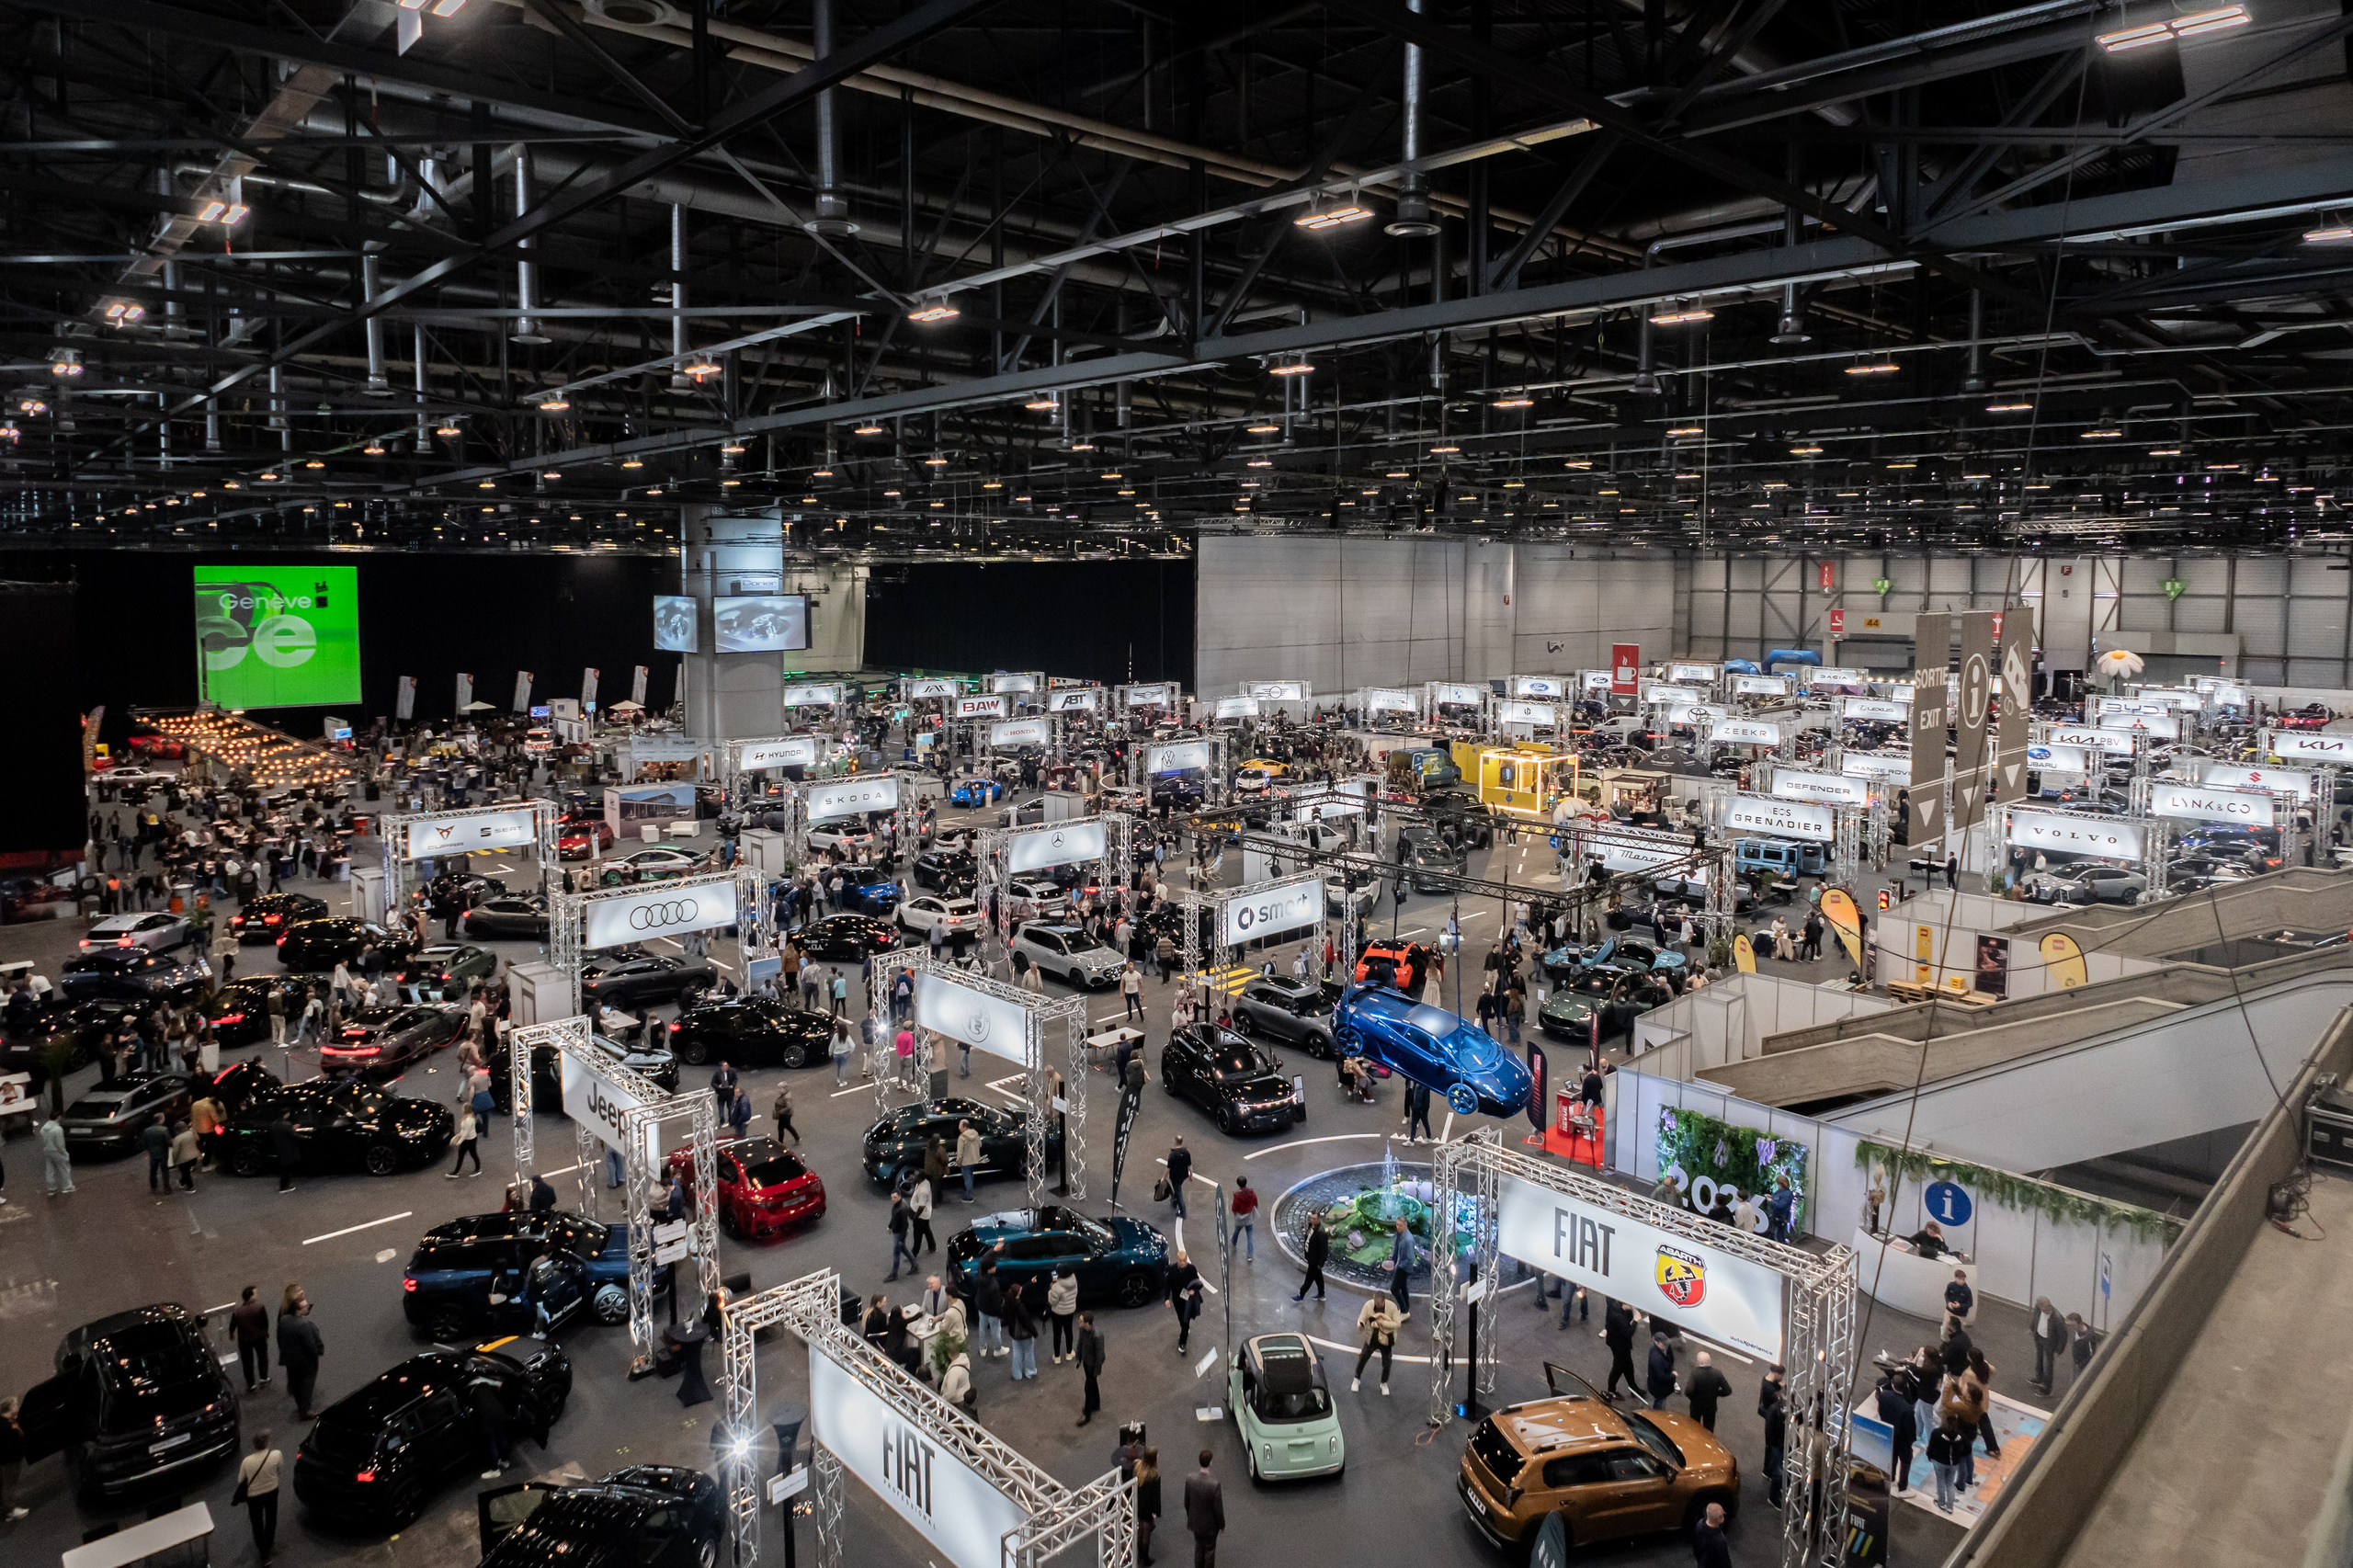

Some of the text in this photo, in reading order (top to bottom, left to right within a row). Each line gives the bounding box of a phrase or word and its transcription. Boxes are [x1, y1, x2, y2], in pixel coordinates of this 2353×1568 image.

[219, 593, 312, 610] Genève
[1915, 666, 1949, 689] SORTIE
[962, 699, 1000, 712] BAW
[1061, 694, 1086, 709] ABT
[1920, 707, 1942, 730] EXIT
[1723, 727, 1768, 738] ZEEKR
[2099, 737, 2120, 746] PBV
[2299, 739, 2344, 752] KIA
[768, 748, 804, 760] HYUNDAI
[1853, 765, 1886, 774] RANGE
[2027, 761, 2057, 769] UBARU
[1786, 781, 1851, 796] DEFENDER
[1763, 804, 1792, 817] INEOS
[494, 825, 523, 835] SEAT
[1733, 813, 1824, 834] GRENADIER
[2032, 826, 2118, 845] VOLVO
[426, 840, 464, 851] CUPRA
[1620, 848, 1666, 864] Maser
[586, 1080, 627, 1139] Jeep
[1553, 1206, 1616, 1278] FIAT
[1658, 1244, 1703, 1267] ABARTH
[1729, 1335, 1774, 1357] autoXperience
[881, 1407, 937, 1518] FIAT
[882, 1478, 938, 1531] PROFESSIONAL
[1849, 1513, 1866, 1530] FIAT
